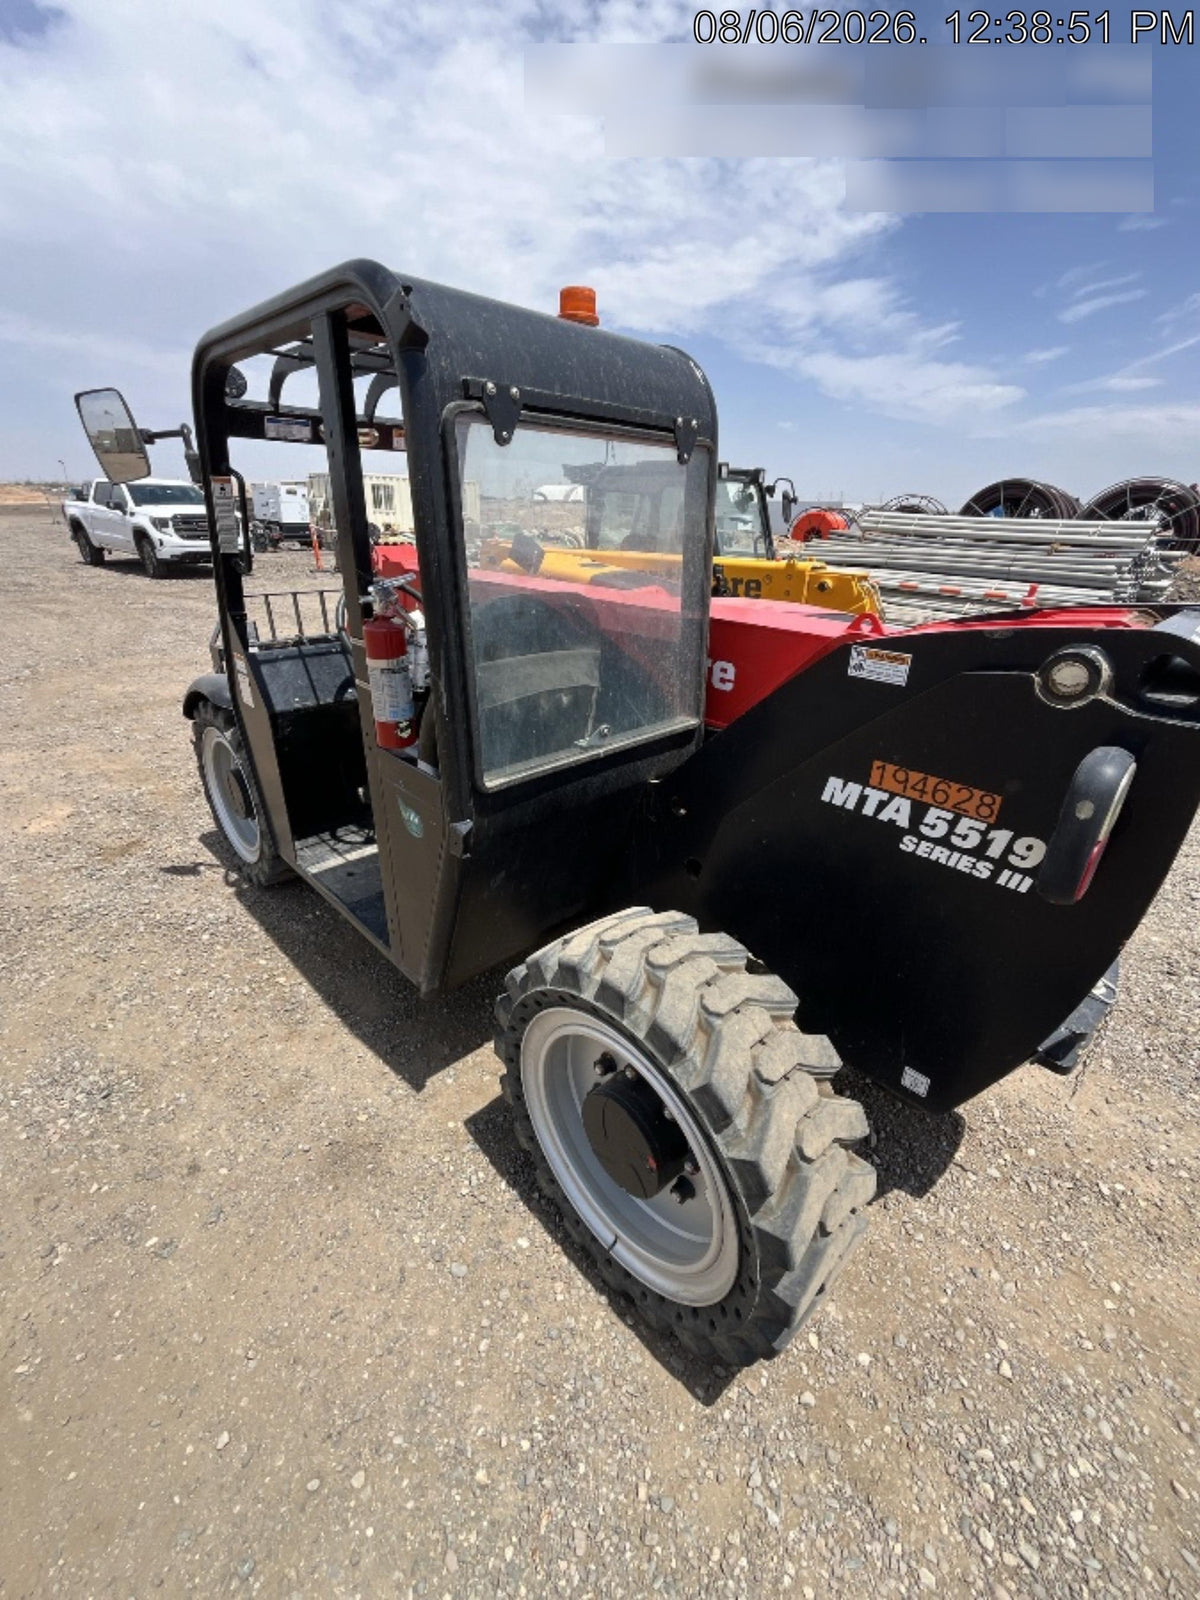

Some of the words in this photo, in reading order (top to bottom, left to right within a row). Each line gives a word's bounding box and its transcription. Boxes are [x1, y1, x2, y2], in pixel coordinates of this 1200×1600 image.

[876, 763, 997, 820] 194628
[820, 776, 912, 829] MTA
[918, 806, 1047, 869] 5519
[899, 834, 995, 880] SERIES
[995, 868, 1034, 893] III
